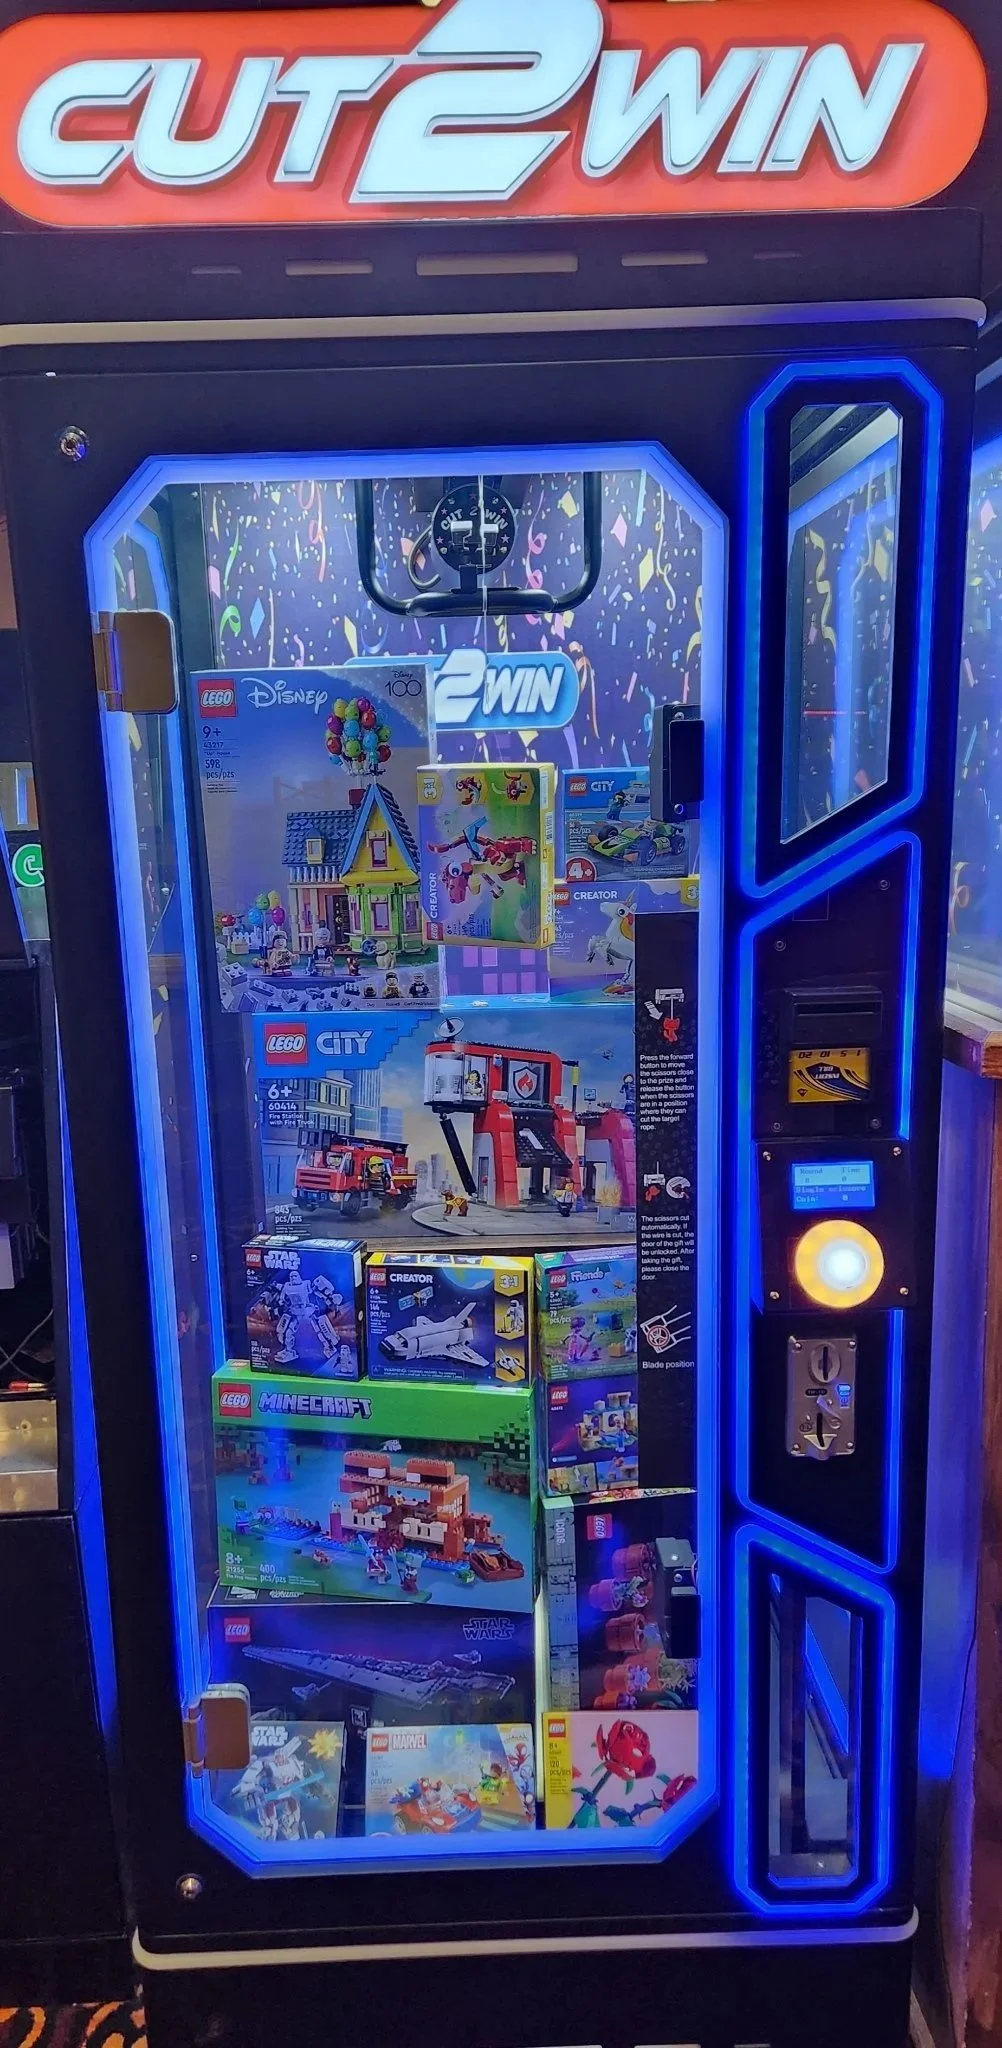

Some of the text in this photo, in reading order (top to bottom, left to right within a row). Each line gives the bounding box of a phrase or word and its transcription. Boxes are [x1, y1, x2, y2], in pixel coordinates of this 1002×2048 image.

[441, 505, 508, 531] CUT 2 WIN
[384, 679, 422, 697] 100
[200, 688, 235, 708] LEGO
[202, 725, 222, 739] 9+
[205, 759, 221, 769] 598
[206, 768, 235, 780] pcs/pzs
[570, 780, 615, 792] LEGO CITY
[568, 862, 593, 879] 4+
[430, 872, 438, 919] CREATOR
[573, 890, 618, 900] CREATOR
[267, 1030, 373, 1055] LEGO CITY
[658, 1077, 674, 1085] prize
[268, 1084, 292, 1100] 6+
[268, 1102, 297, 1110] 60414
[662, 1115, 680, 1123] target
[274, 1204, 290, 1214] 843
[274, 1213, 303, 1224] pcs/pzs
[641, 1223, 682, 1231] automatically.
[672, 1231, 684, 1239] cut,
[674, 1239, 684, 1247] gift
[264, 1250, 300, 1261] STAR
[671, 1256, 683, 1264] gift,
[264, 1259, 301, 1270] WARS
[641, 1265, 662, 1273] please
[369, 1273, 386, 1281] LEGO
[389, 1273, 434, 1284] CREATOR
[550, 1266, 604, 1283] LEGO Friends
[641, 1273, 657, 1281] door.
[549, 1291, 560, 1299] 5+
[642, 1360, 695, 1370] Blade position
[551, 1391, 568, 1399] LEGO
[220, 1392, 372, 1419] LEGO MINECRAFT
[594, 1515, 607, 1538] LEGO
[225, 1552, 243, 1564] 8+
[259, 1564, 276, 1574] 400
[260, 1573, 287, 1584] pcs/pzs
[463, 1617, 516, 1629] STAR
[225, 1624, 250, 1636] LEGO
[463, 1628, 516, 1641] WARS
[251, 1725, 288, 1737] STAR
[392, 1733, 428, 1750] MARVEL
